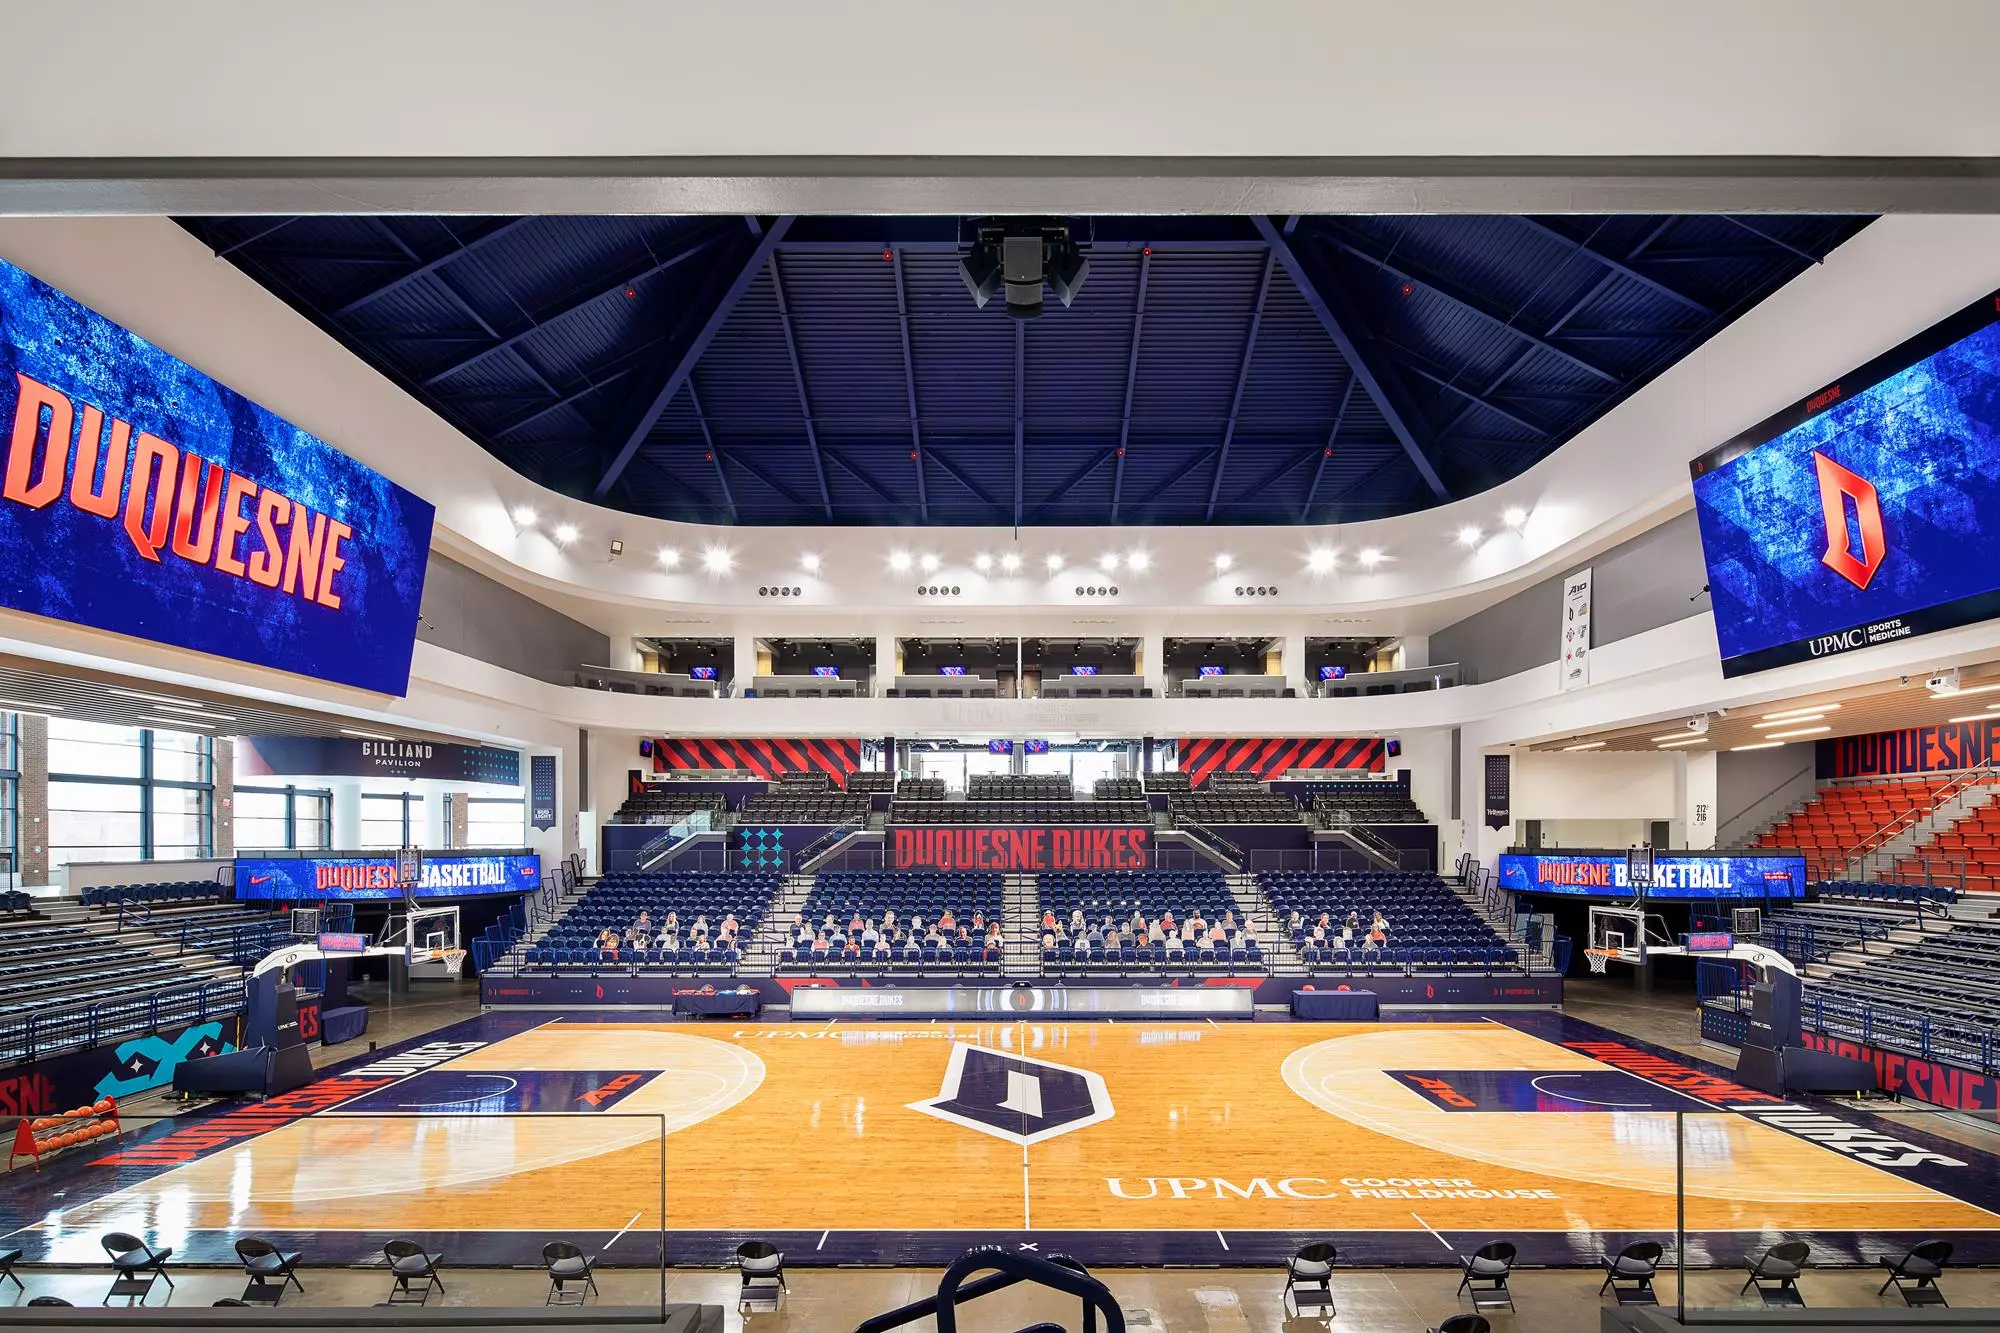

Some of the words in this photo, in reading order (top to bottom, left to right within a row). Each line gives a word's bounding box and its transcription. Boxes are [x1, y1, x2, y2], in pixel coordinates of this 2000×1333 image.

[1806, 385, 1841, 413] DUQUESNE
[3, 371, 352, 609] DUQUESNE
[1809, 629, 1863, 656] UPMC
[1867, 619, 1901, 634] SPORTS
[1869, 626, 1911, 643] MEDICINE
[362, 742, 433, 759] GILLIAND
[375, 759, 421, 767] PAVILION
[1696, 813, 1706, 821] 216
[895, 829, 1045, 871] DUQUESNE
[1052, 829, 1146, 870] DUKES
[1538, 862, 1611, 887] DUQUESNE
[1614, 863, 1733, 889] BKETBALL
[340, 1041, 488, 1076] DUKES
[1726, 1104, 1968, 1167] DUKES
[1106, 1177, 1338, 1199] UPMC
[1340, 1178, 1476, 1188] COOPER
[1349, 1188, 1562, 1200] FIELDHOUSE
